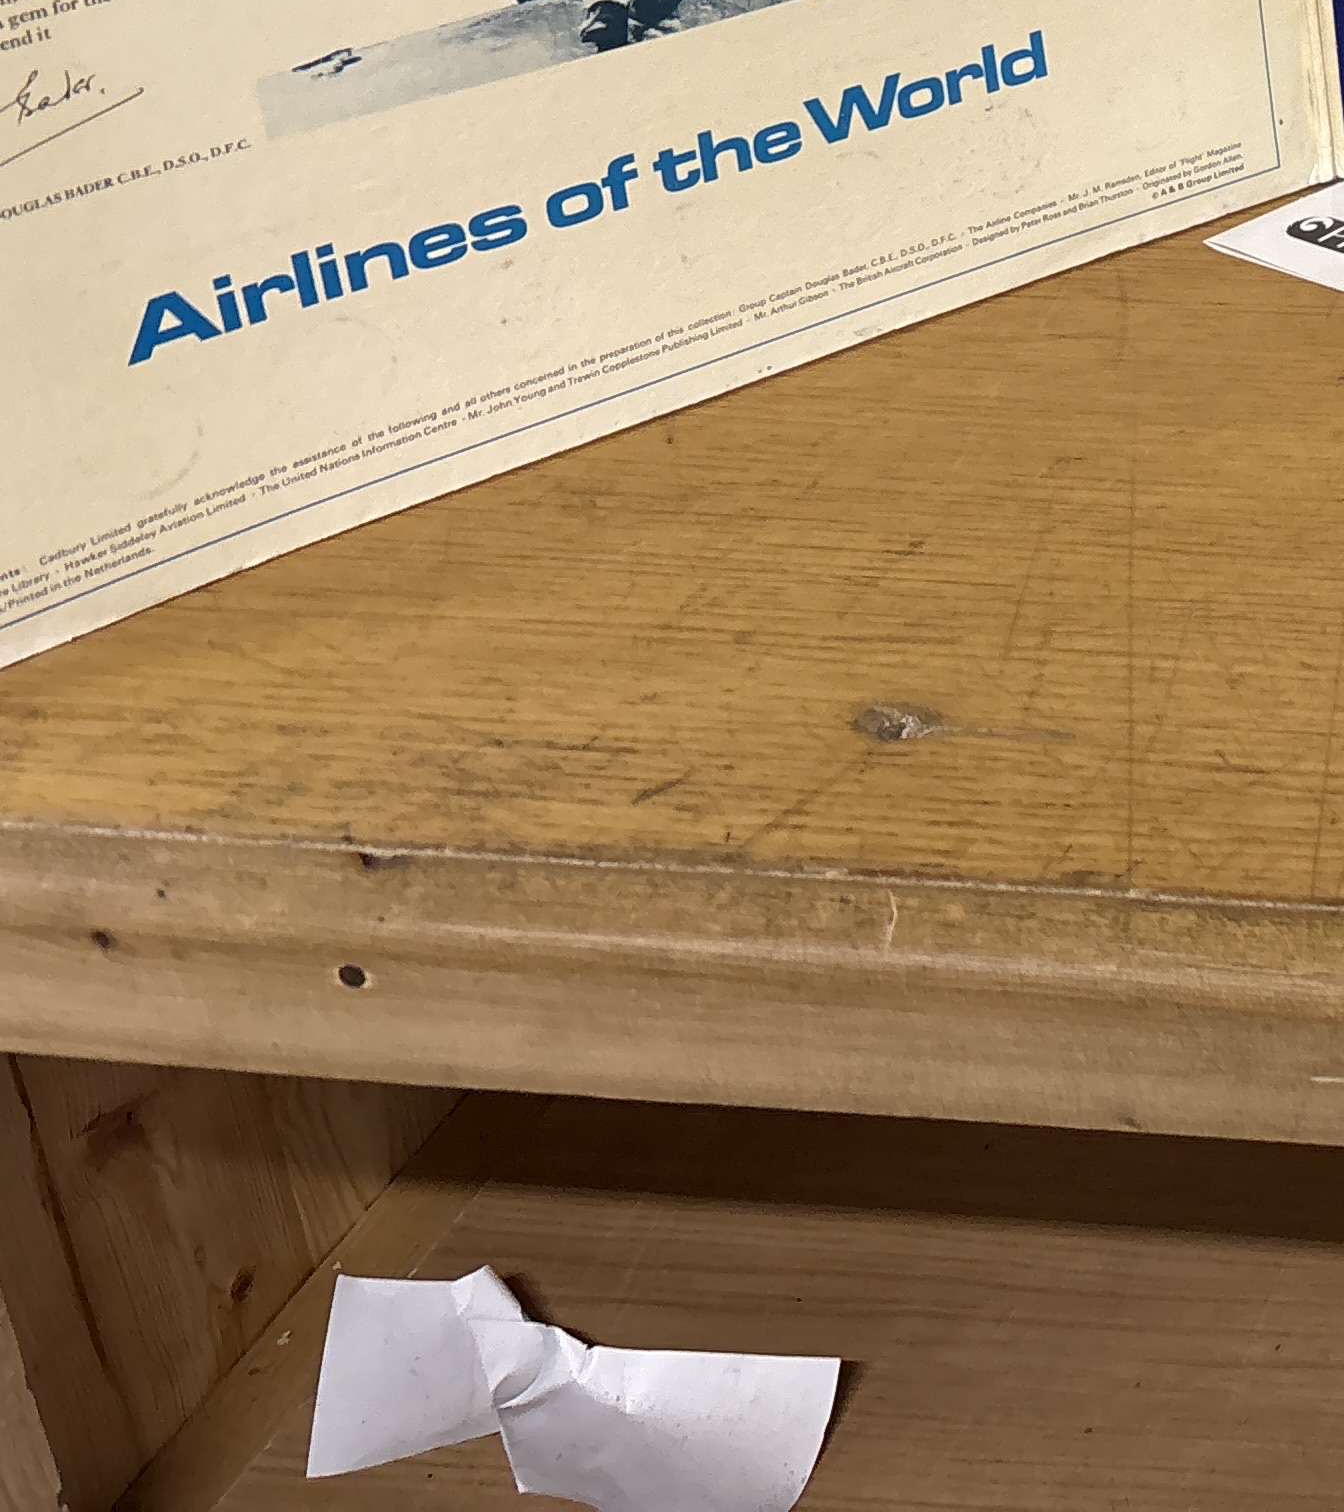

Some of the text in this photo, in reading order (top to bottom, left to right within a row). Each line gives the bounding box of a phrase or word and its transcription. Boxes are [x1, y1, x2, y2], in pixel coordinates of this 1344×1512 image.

[65, 178, 114, 201] BADER
[131, 32, 1046, 364] Airlines of the World
